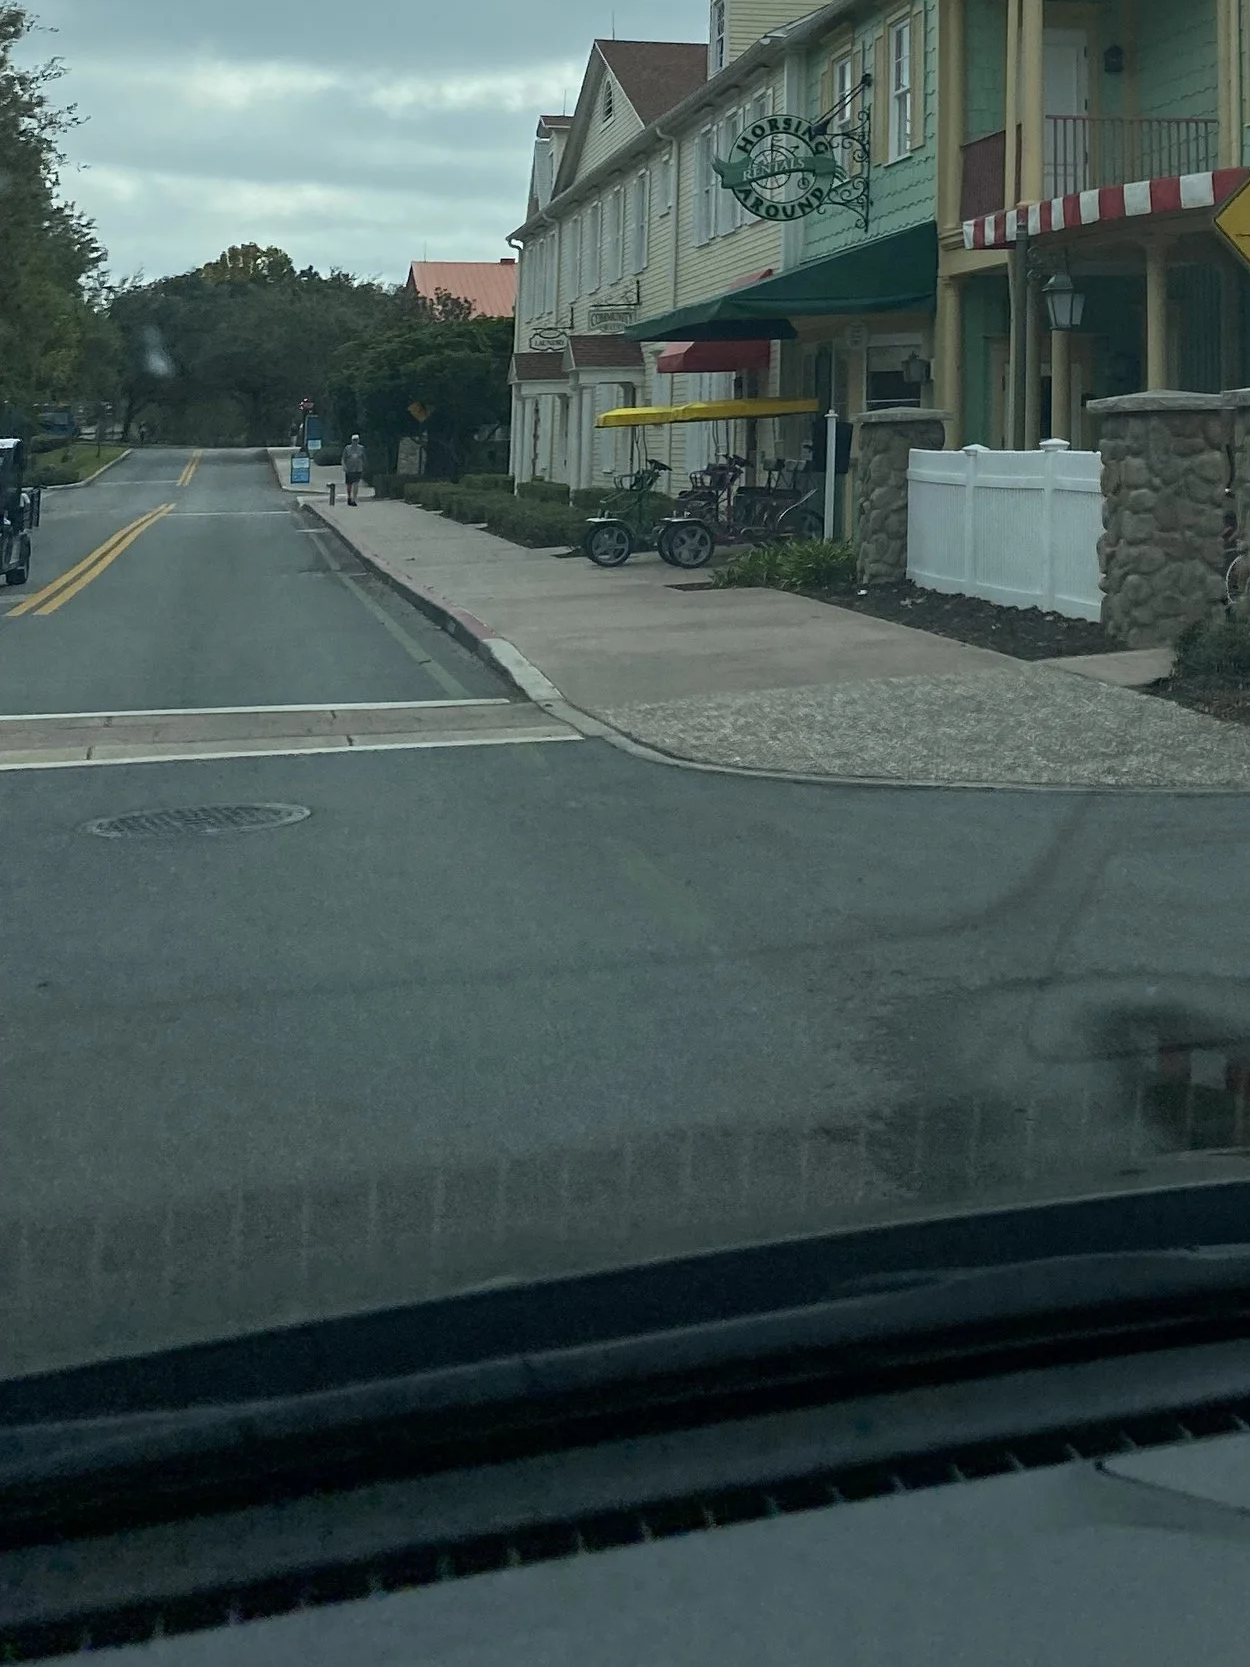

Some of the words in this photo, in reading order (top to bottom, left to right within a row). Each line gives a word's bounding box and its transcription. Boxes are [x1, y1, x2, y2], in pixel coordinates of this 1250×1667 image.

[736, 117, 829, 156] HORSING
[742, 158, 805, 181] RENTALS
[736, 186, 824, 219] AROUND
